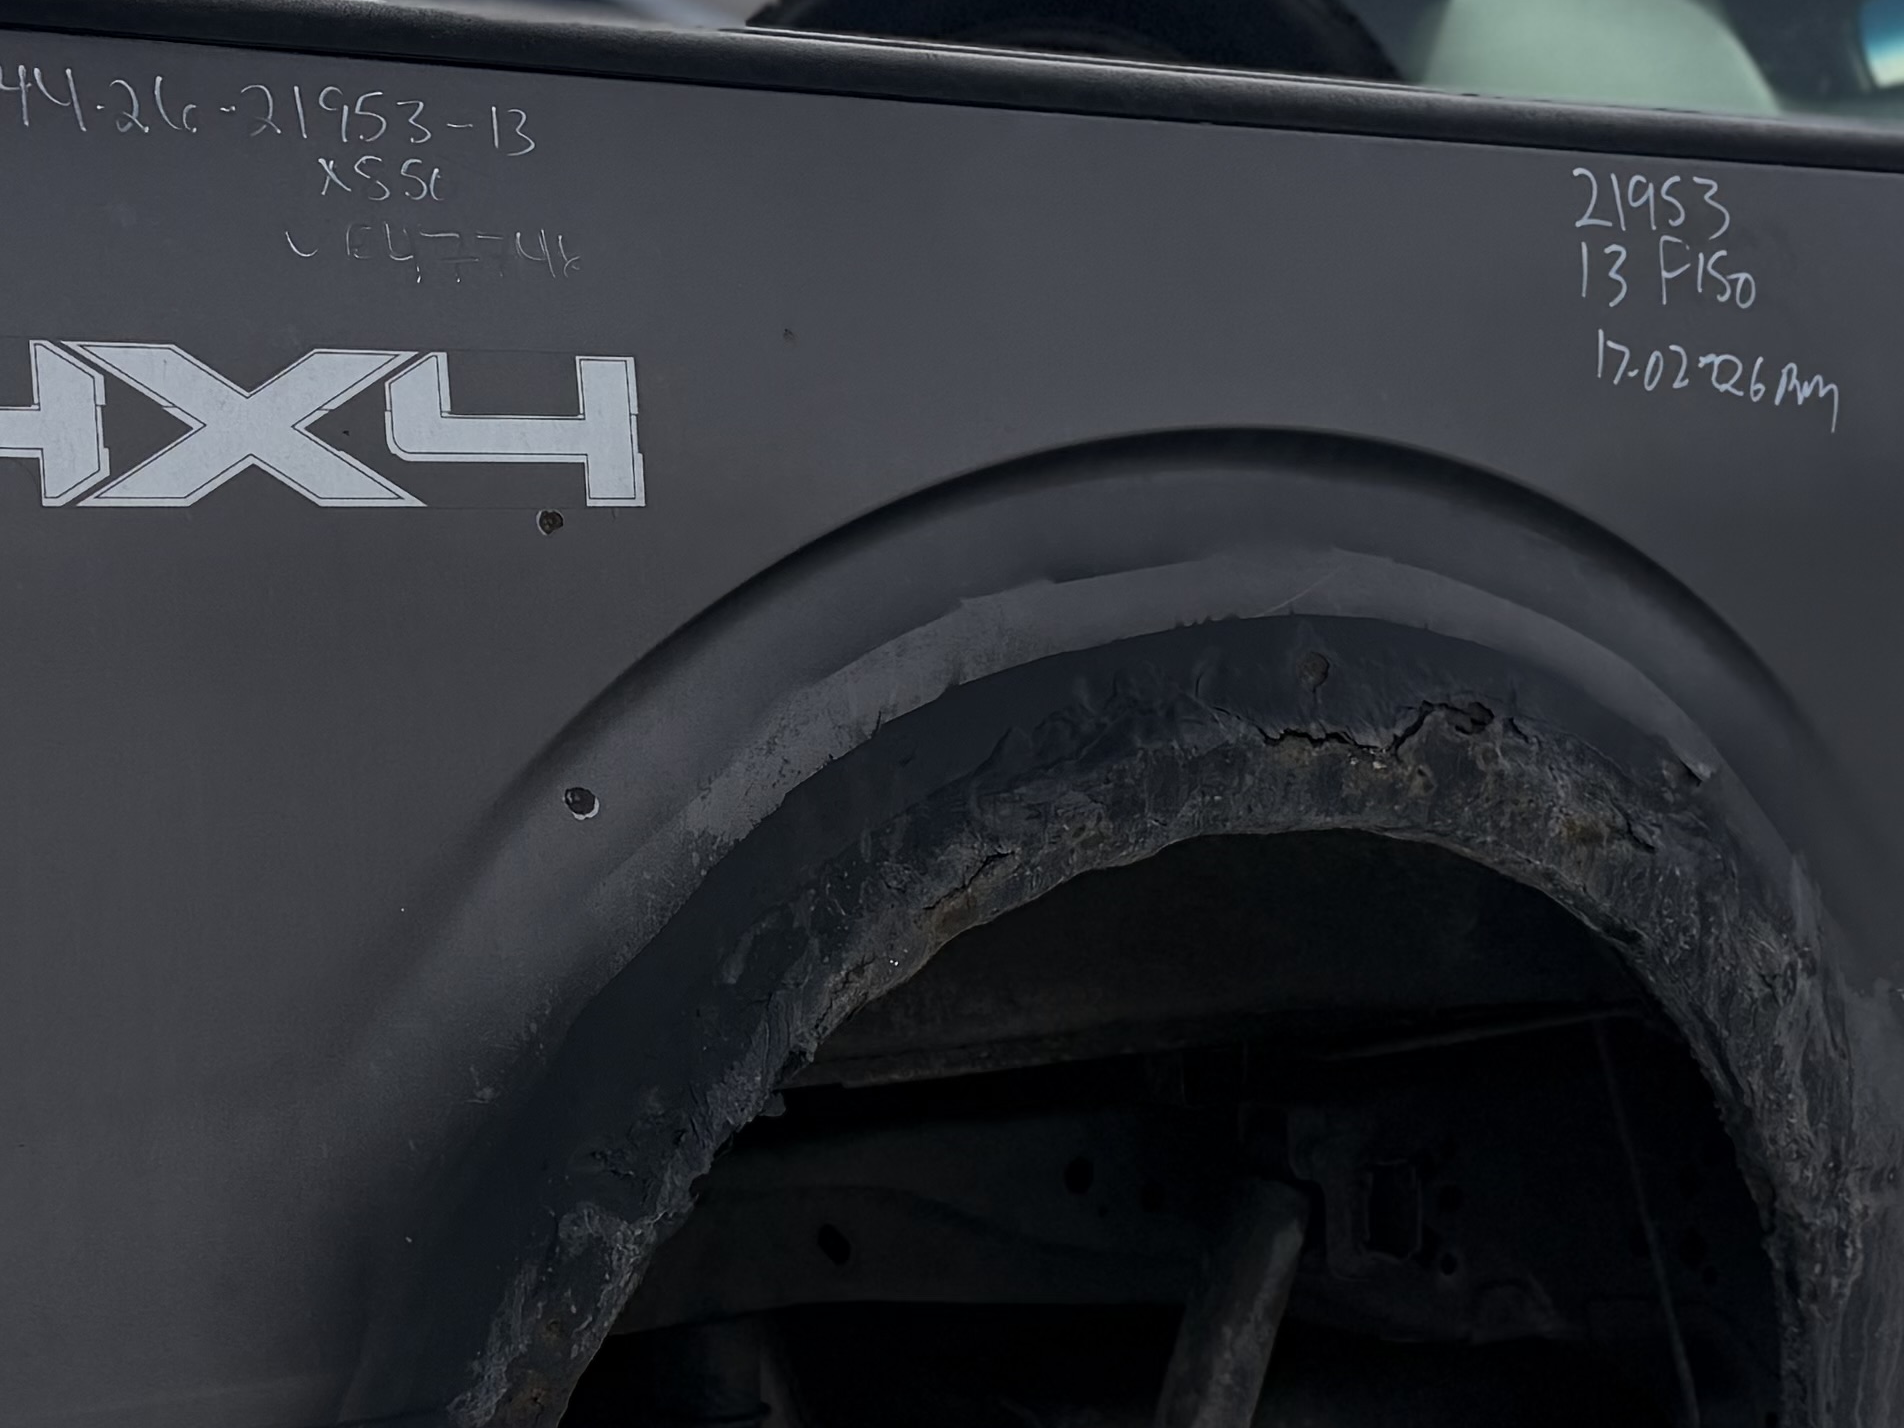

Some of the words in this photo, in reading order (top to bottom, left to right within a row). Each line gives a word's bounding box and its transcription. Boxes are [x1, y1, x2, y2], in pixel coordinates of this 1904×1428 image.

[1571, 166, 1732, 242] 21953
[1580, 240, 1629, 309] 13
[1658, 234, 1757, 310] F150
